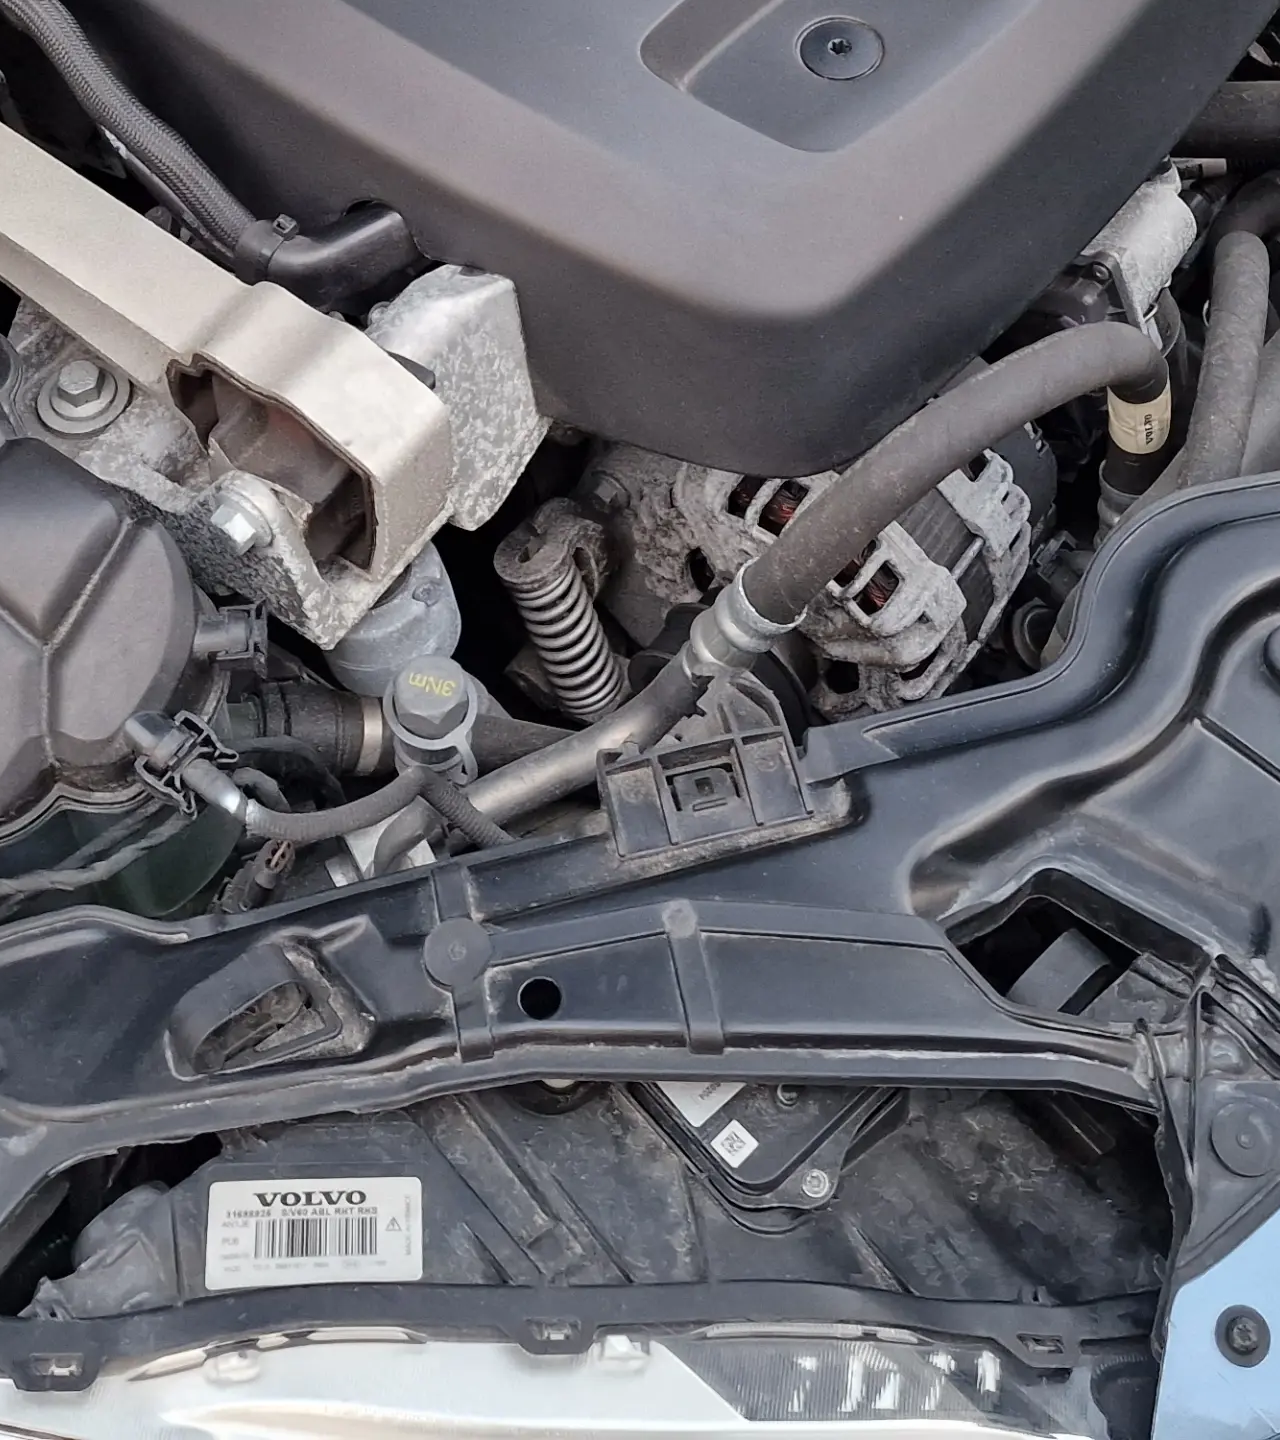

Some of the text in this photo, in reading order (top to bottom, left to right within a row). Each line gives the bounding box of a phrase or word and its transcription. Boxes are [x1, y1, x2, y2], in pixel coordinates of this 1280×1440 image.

[1144, 413, 1154, 446] VOLVO
[409, 672, 456, 696] 3Nm
[253, 1190, 367, 1208] VOLVO
